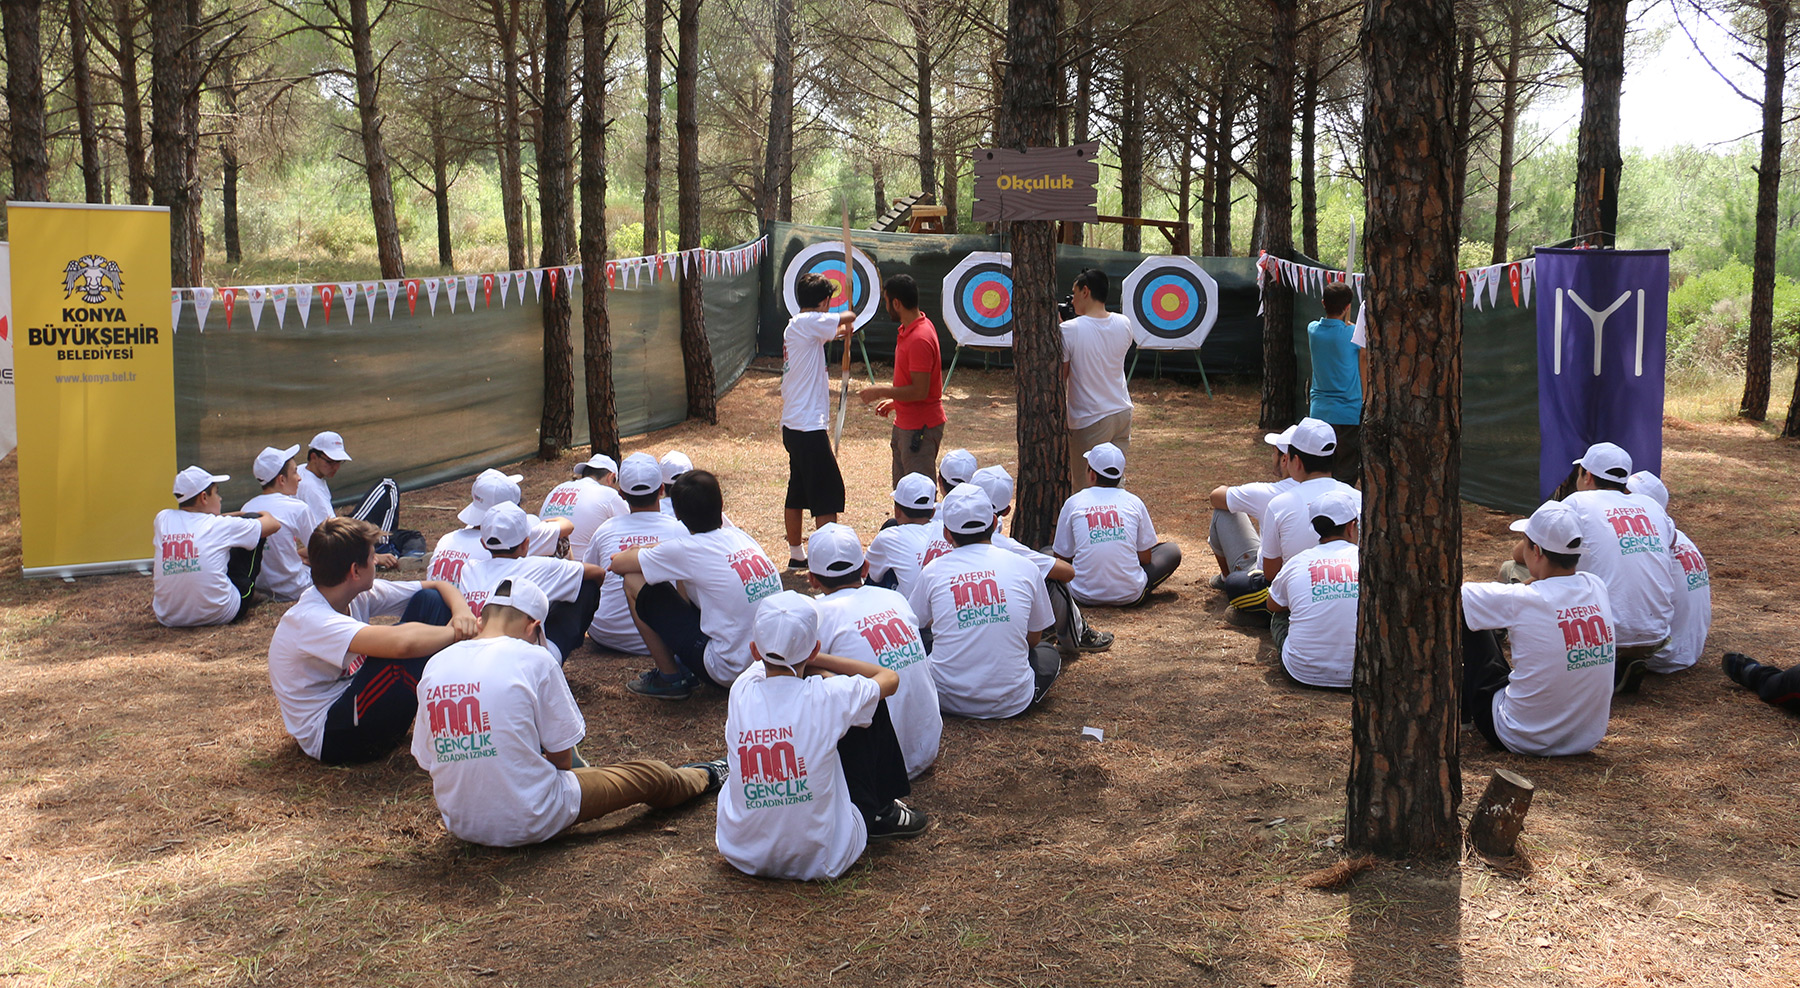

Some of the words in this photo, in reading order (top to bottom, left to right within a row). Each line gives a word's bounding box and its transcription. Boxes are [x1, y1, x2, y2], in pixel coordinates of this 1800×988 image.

[997, 174, 1074, 193] Okçuluk
[62, 308, 127, 323] KONYA
[28, 323, 159, 348] BÜYÜKŞEHİR
[57, 346, 133, 360] BELEDİYESİ
[55, 371, 137, 384] www.konya.bel.tr
[1085, 510, 1121, 531] 100
[1607, 514, 1656, 539] 100
[162, 540, 194, 562] 100
[730, 554, 773, 586] 100
[1308, 564, 1353, 587] 100
[950, 579, 1000, 611] 100
[860, 617, 914, 657] 100
[1558, 615, 1609, 651] 100
[426, 696, 482, 738] 100
[738, 740, 799, 784] 100
